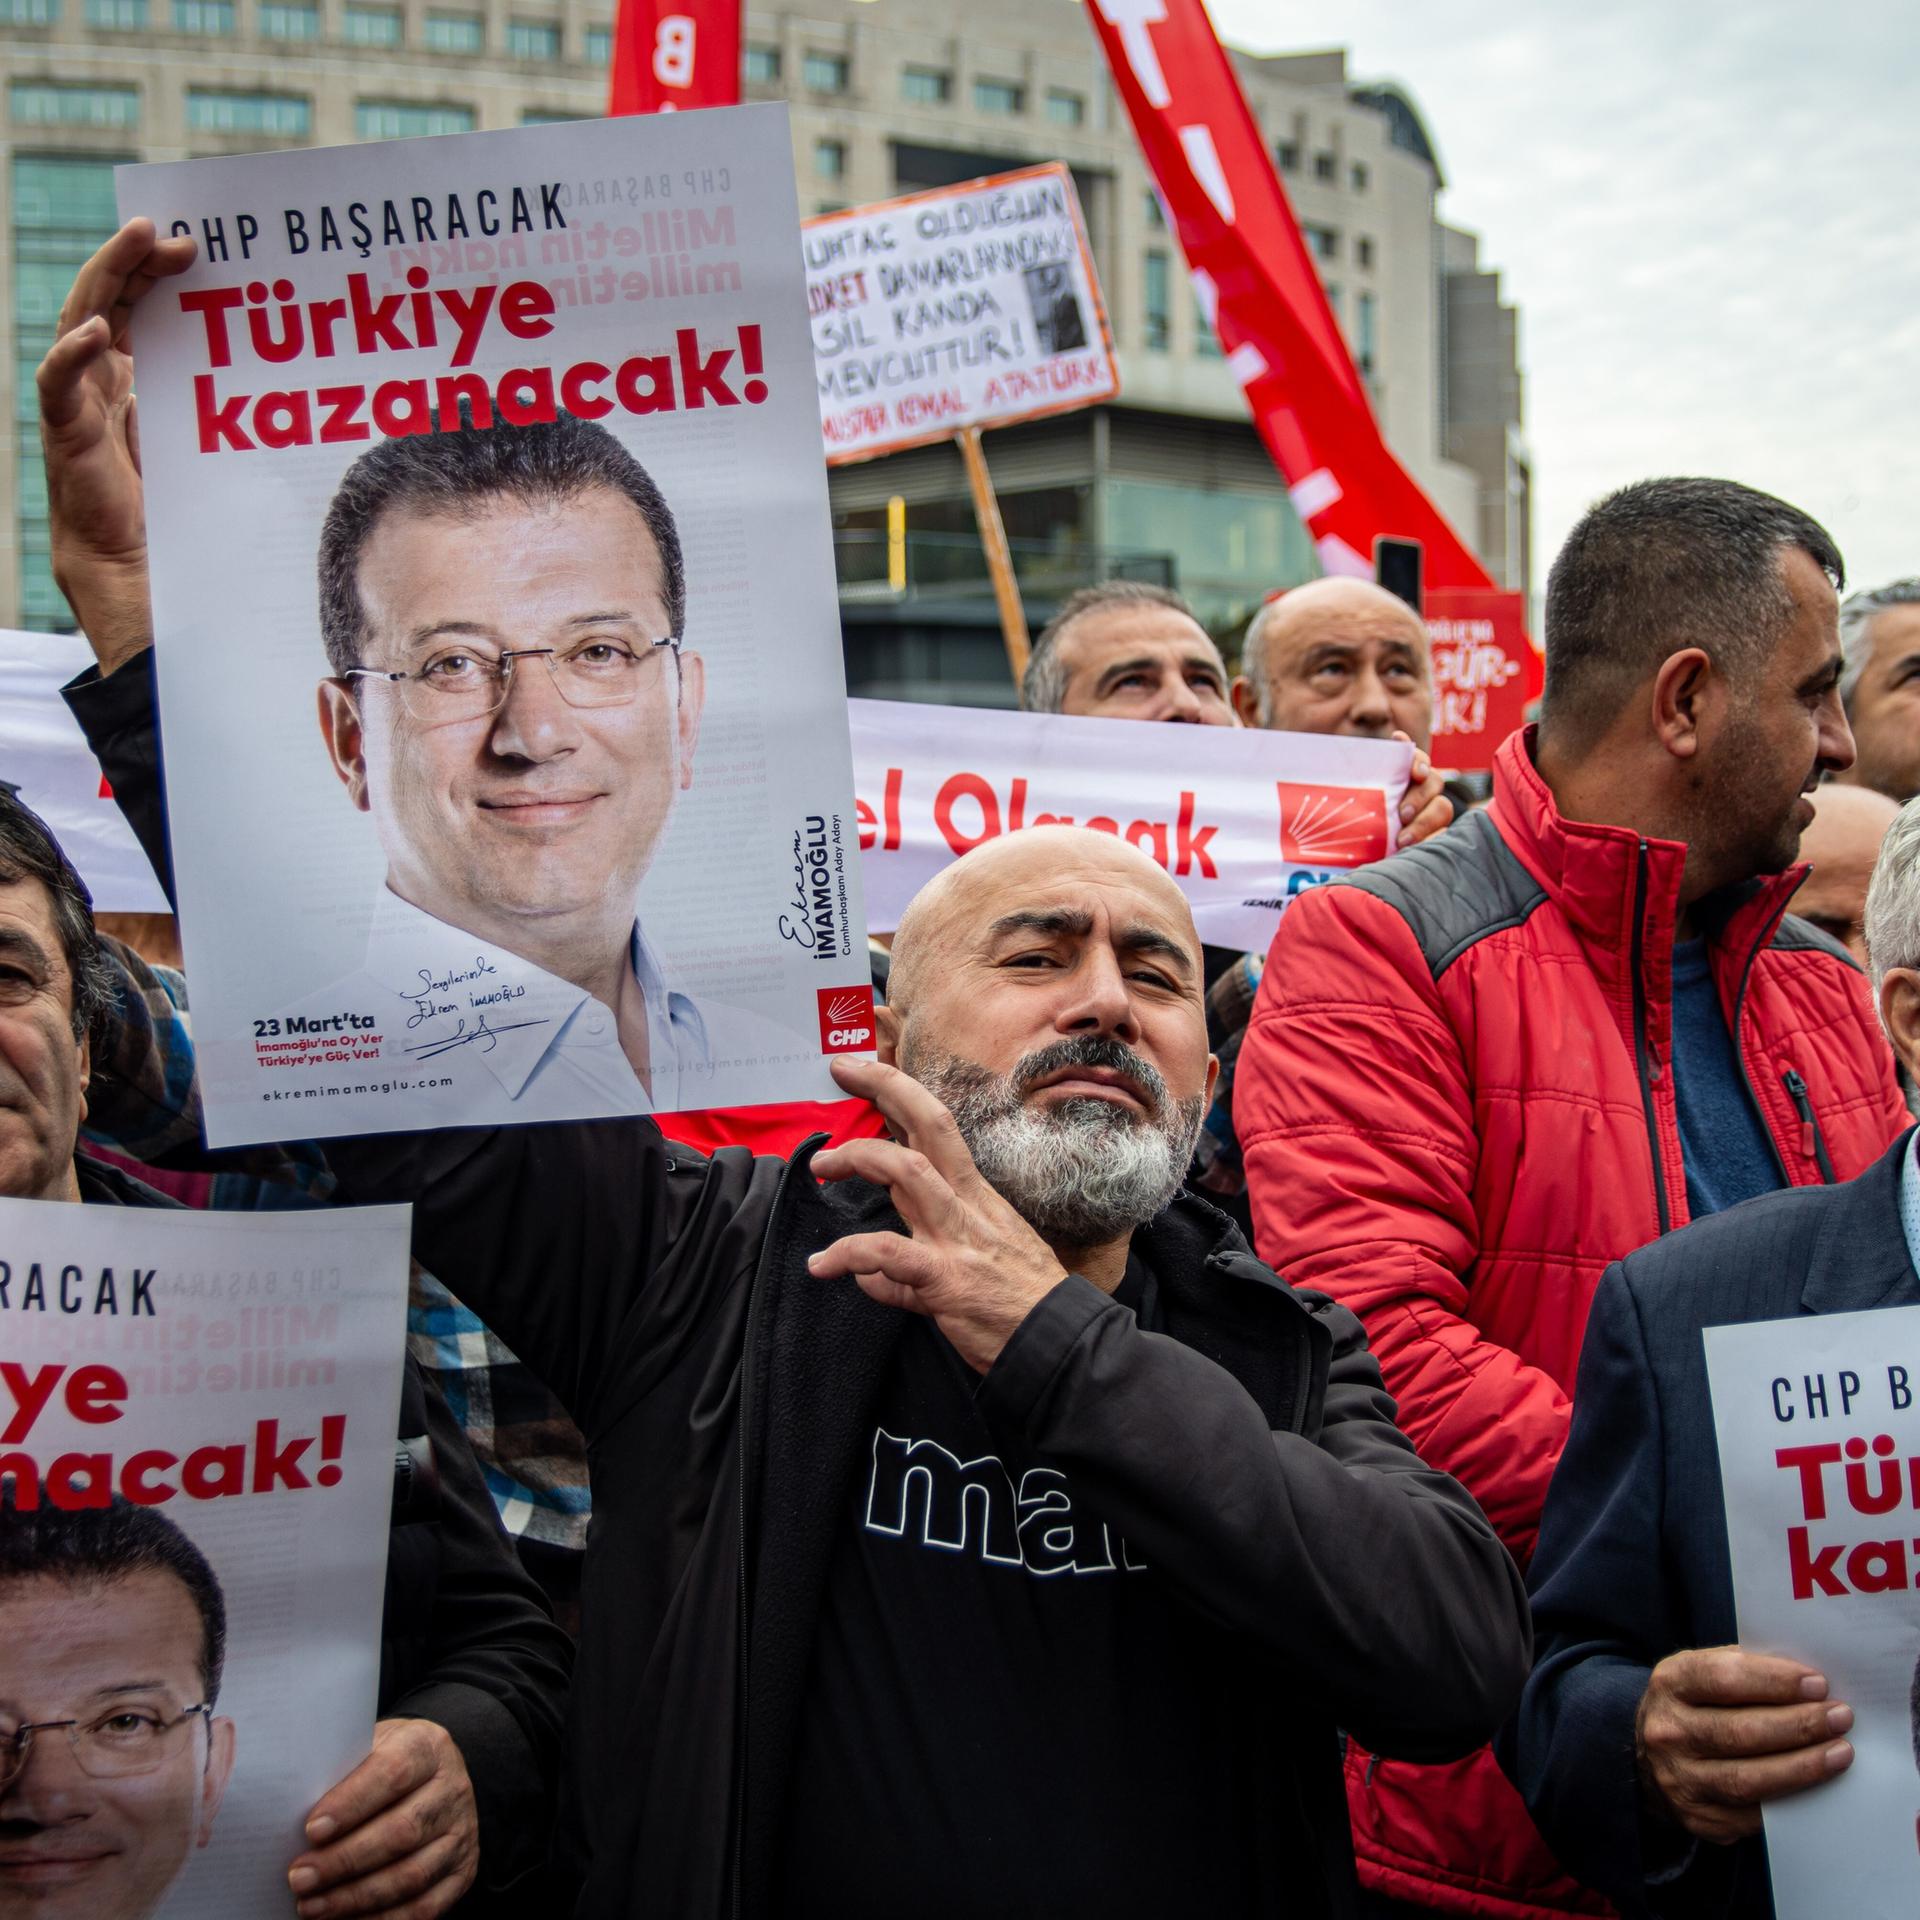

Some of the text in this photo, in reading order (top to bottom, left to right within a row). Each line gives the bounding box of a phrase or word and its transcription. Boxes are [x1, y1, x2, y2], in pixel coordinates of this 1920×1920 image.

[284, 182, 567, 259] BAŞARACAK
[180, 266, 555, 368] Türkiye
[195, 324, 768, 453] kazanacak!
[934, 773, 1219, 880] Olak
[806, 815, 838, 960] İMAMOĞLU
[831, 814, 852, 956] Cumhurbaşkanı Aday Adayı
[253, 1012, 376, 1038] 23 Mart'ta
[255, 1033, 384, 1055] İmamoğlu'na Oy Ver
[257, 1048, 380, 1068] Türkiye'ye Güç Ver!
[828, 1028, 871, 1046] CHP
[263, 1077, 453, 1101] ekremimamoglu.com
[1772, 1366, 1912, 1422] CHP B
[0, 1414, 346, 1511] nacak!
[866, 1427, 1147, 1575] ma
[1787, 1527, 1920, 1600] ka
